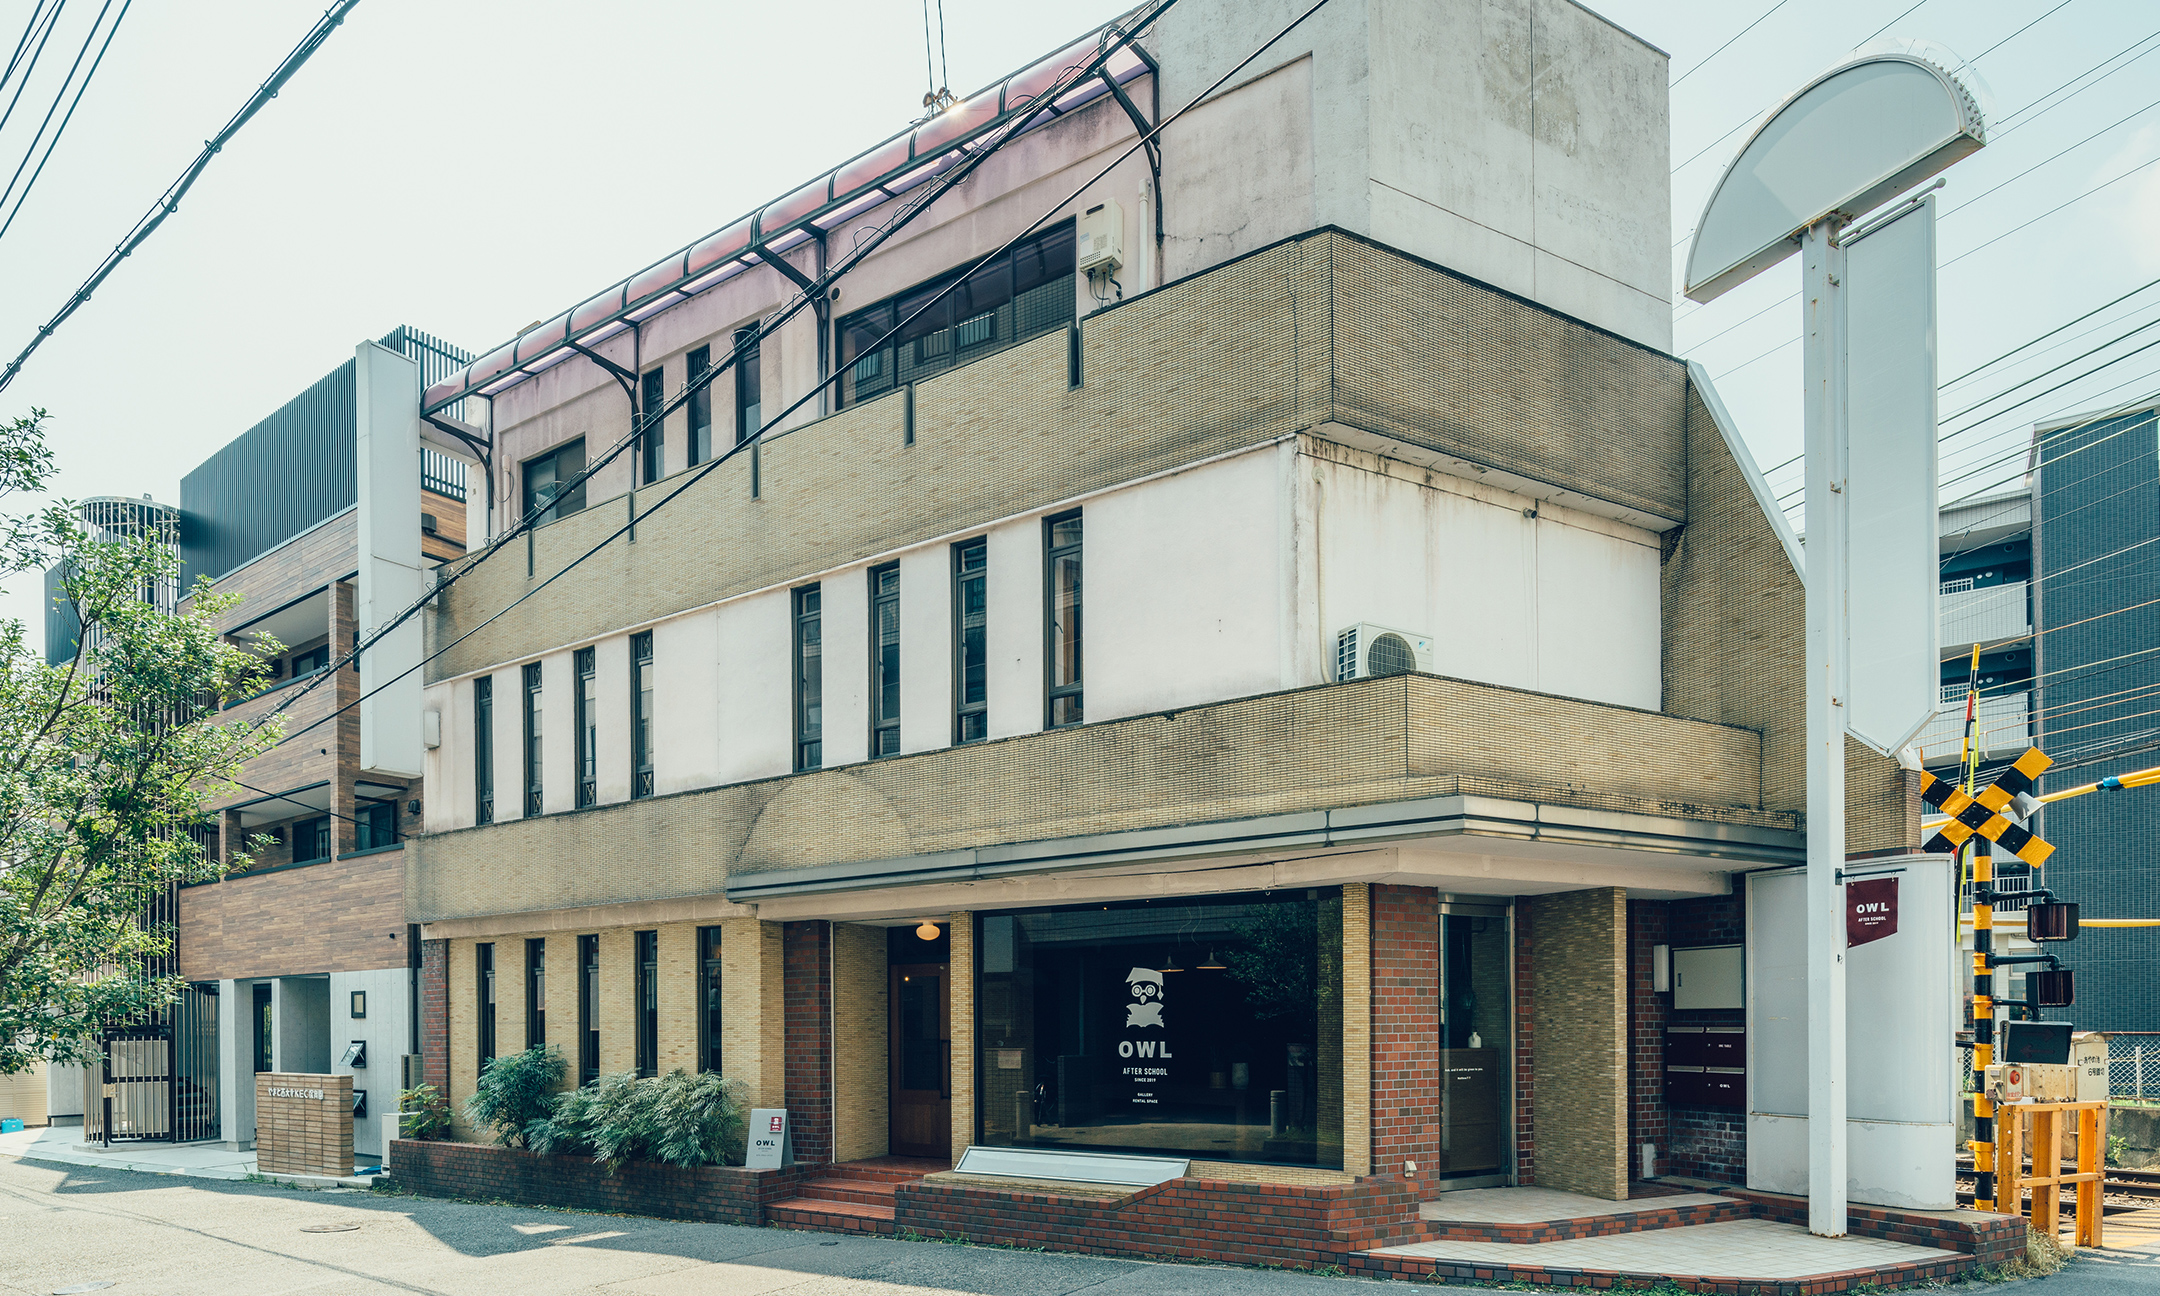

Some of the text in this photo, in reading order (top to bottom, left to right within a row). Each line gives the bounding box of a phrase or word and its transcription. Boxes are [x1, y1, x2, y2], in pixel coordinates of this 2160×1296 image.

[1856, 902, 1889, 914] OWL
[1118, 1040, 1172, 1058] OWL
[1122, 1067, 1168, 1076] AFTER SCHOOL
